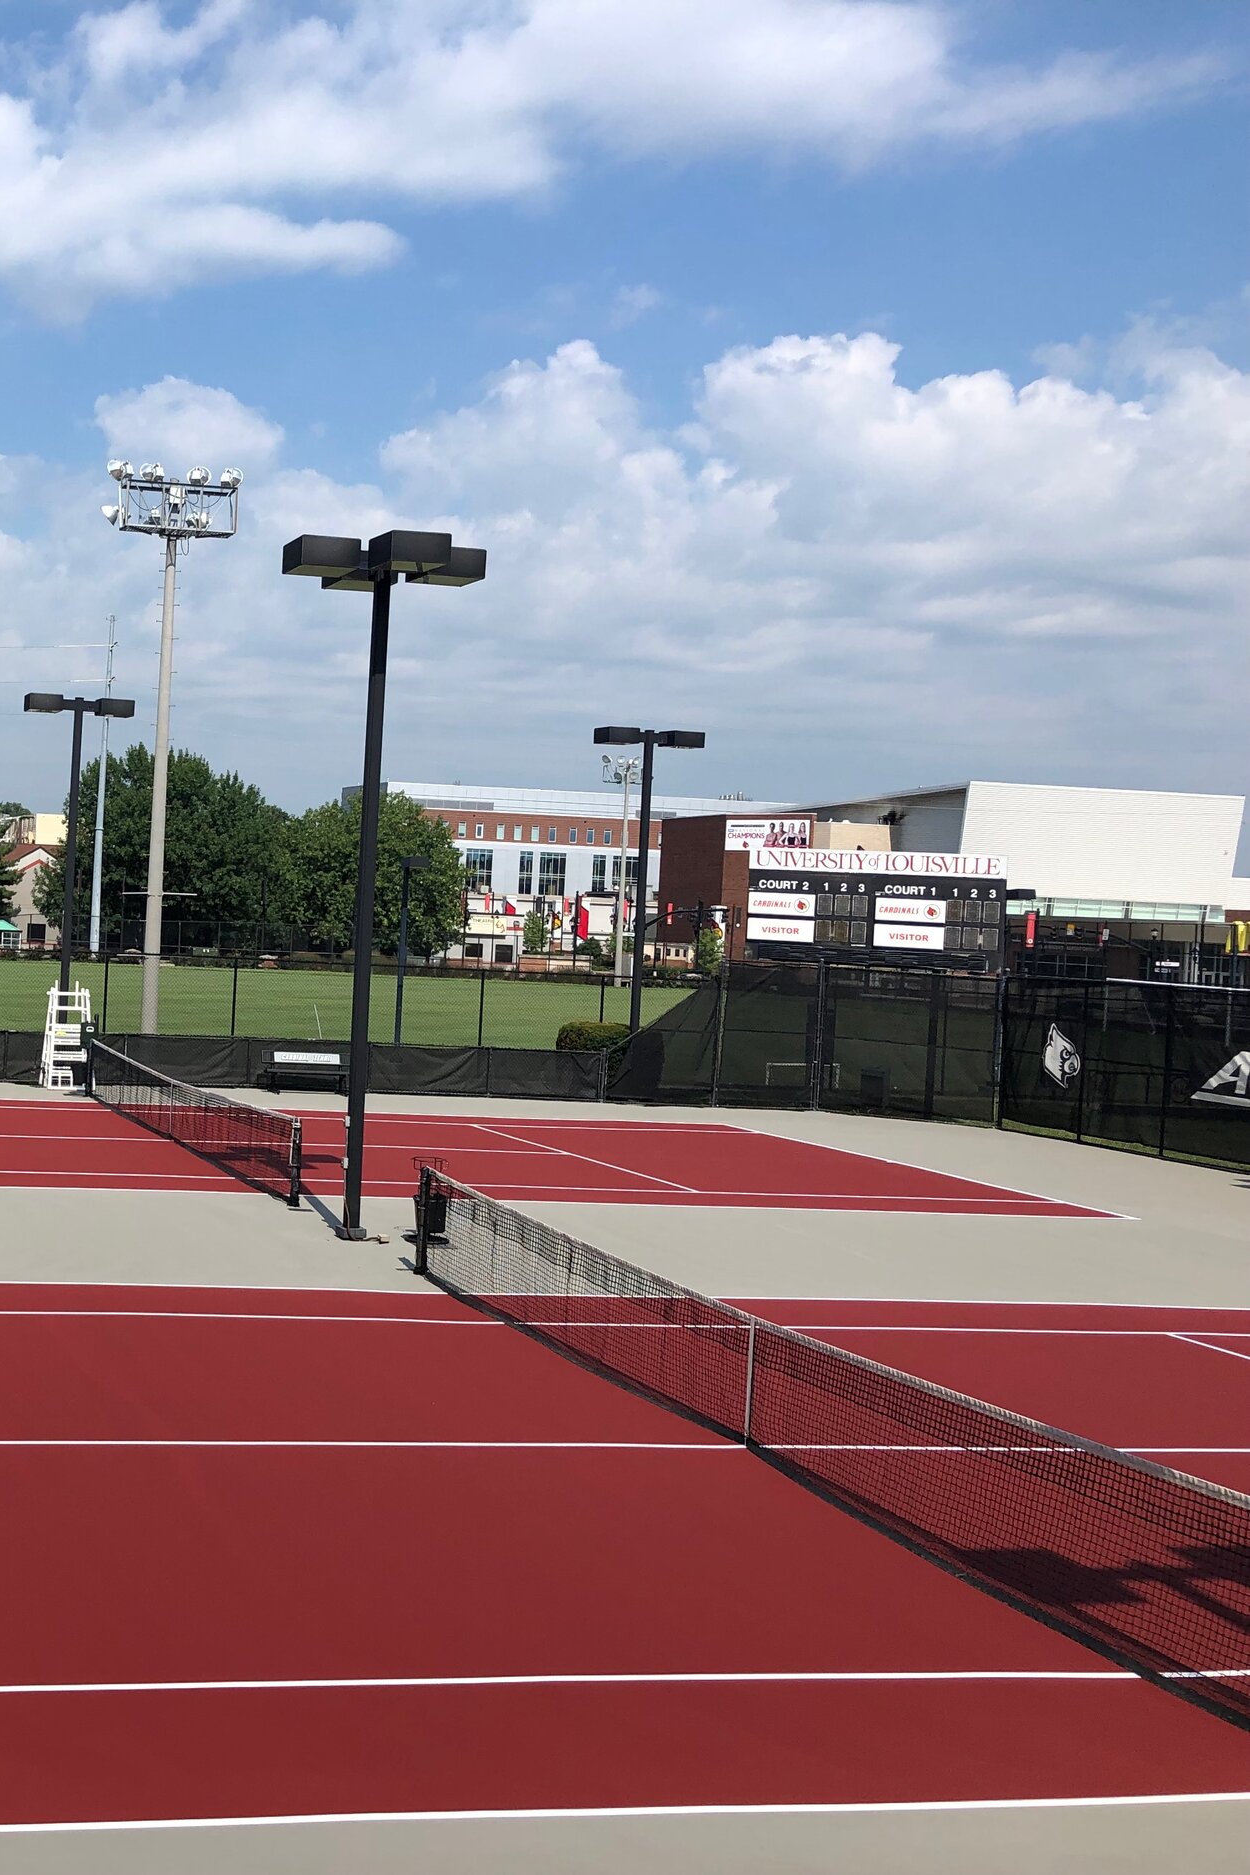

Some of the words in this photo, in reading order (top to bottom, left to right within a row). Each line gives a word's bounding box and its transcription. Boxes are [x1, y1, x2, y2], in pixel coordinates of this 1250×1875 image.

[756, 850, 868, 870] UNIVERSITY
[868, 855, 881, 870] of
[885, 854, 1000, 875] LOUISVILLE
[758, 879, 799, 890] COURT
[802, 881, 810, 891] 2
[823, 882, 830, 891] 1
[840, 883, 848, 892] 2
[858, 884, 866, 893] 3
[884, 885, 926, 895] COURT
[930, 887, 936, 896] 1
[952, 888, 958, 897] 1
[970, 888, 978, 898] 2
[989, 889, 997, 898] 3
[753, 899, 792, 909] CARDINALS
[879, 906, 919, 914] CARDINALS
[762, 926, 800, 935] VISITOR
[889, 932, 929, 942] VISITOR
